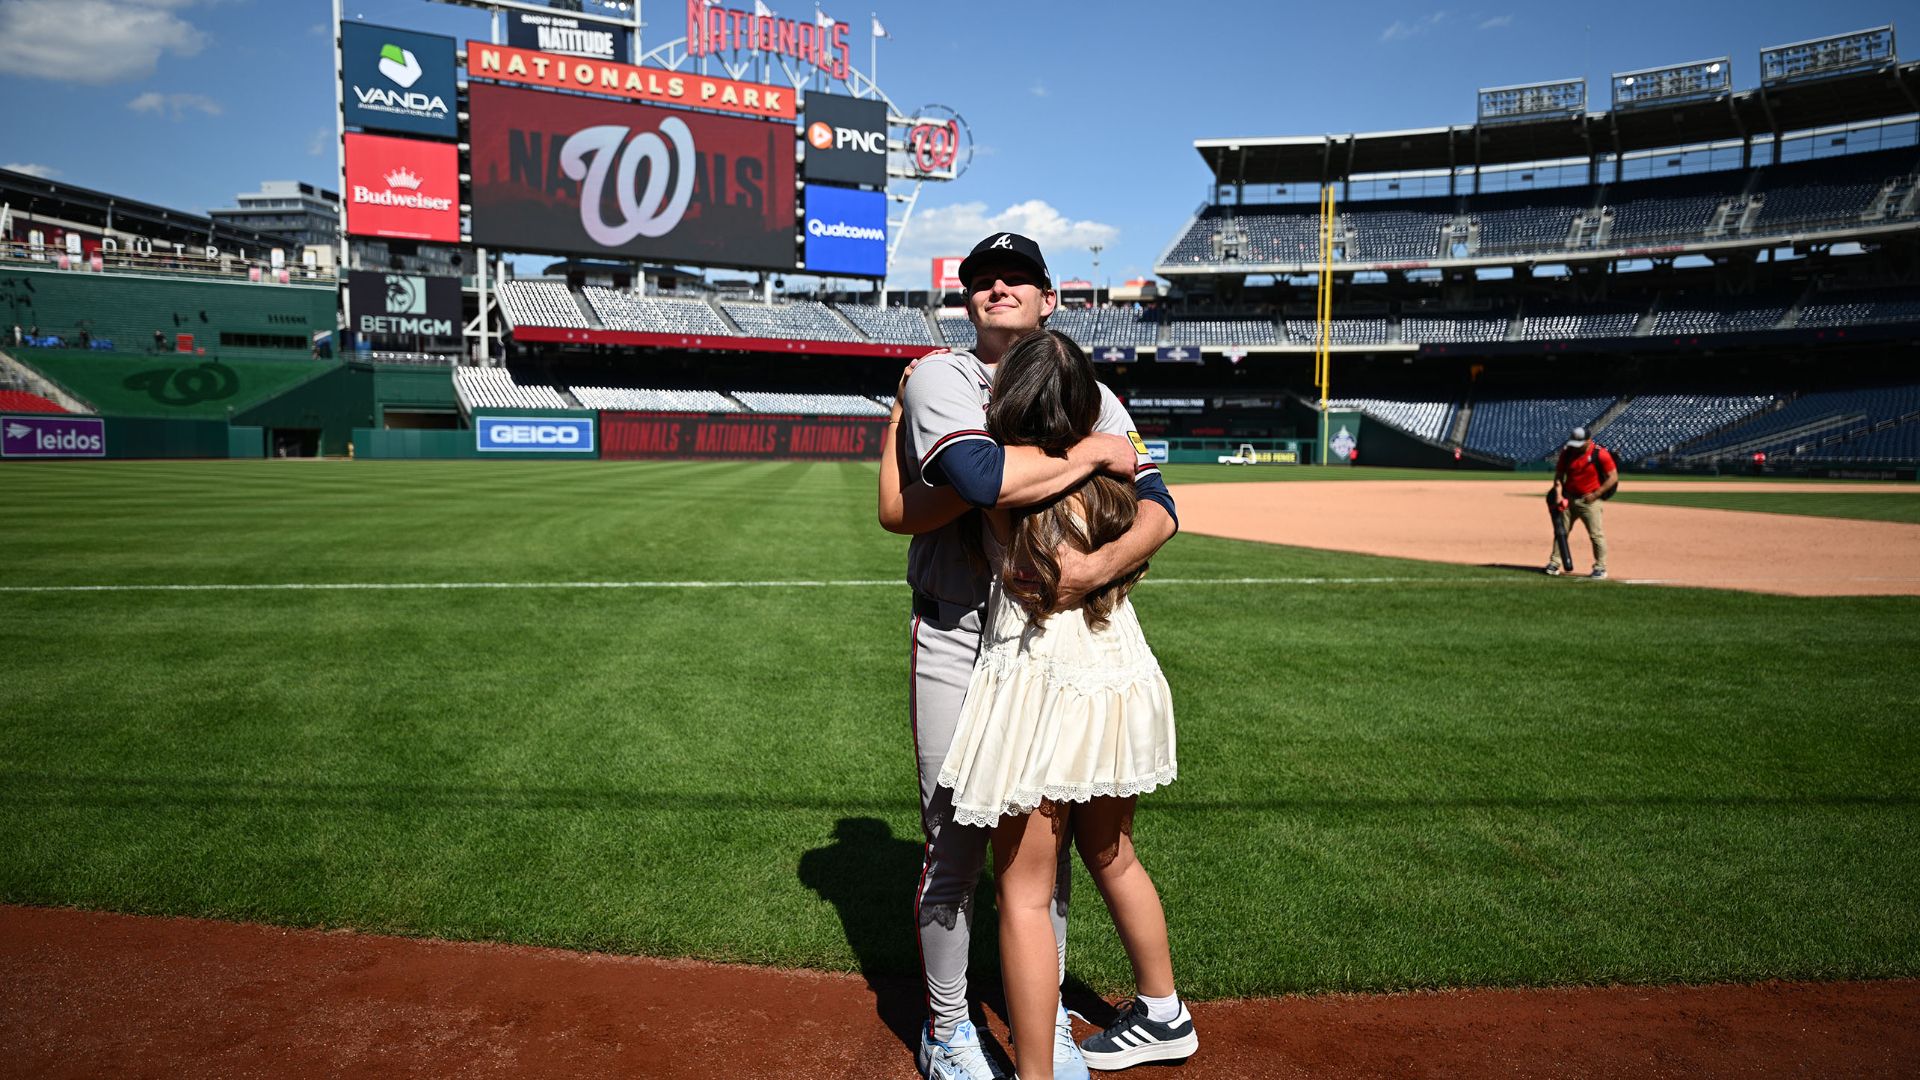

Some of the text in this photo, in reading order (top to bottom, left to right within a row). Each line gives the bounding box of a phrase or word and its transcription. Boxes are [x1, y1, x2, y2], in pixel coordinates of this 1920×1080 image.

[521, 14, 551, 25] SHOW
[537, 26, 614, 55] NATITUDE
[686, 0, 850, 80] NATIONALS
[481, 50, 781, 111] NATIONALS PARK
[353, 85, 449, 113] VANDA
[835, 127, 886, 155] PNC
[353, 185, 452, 211] Budweiser
[807, 218, 885, 241] Qualcomm
[360, 315, 452, 336] BETMGM
[36, 428, 101, 450] leidos
[490, 424, 580, 444] GEICO
[695, 423, 777, 452] NATIONALS
[790, 424, 866, 453] NATIONALS
